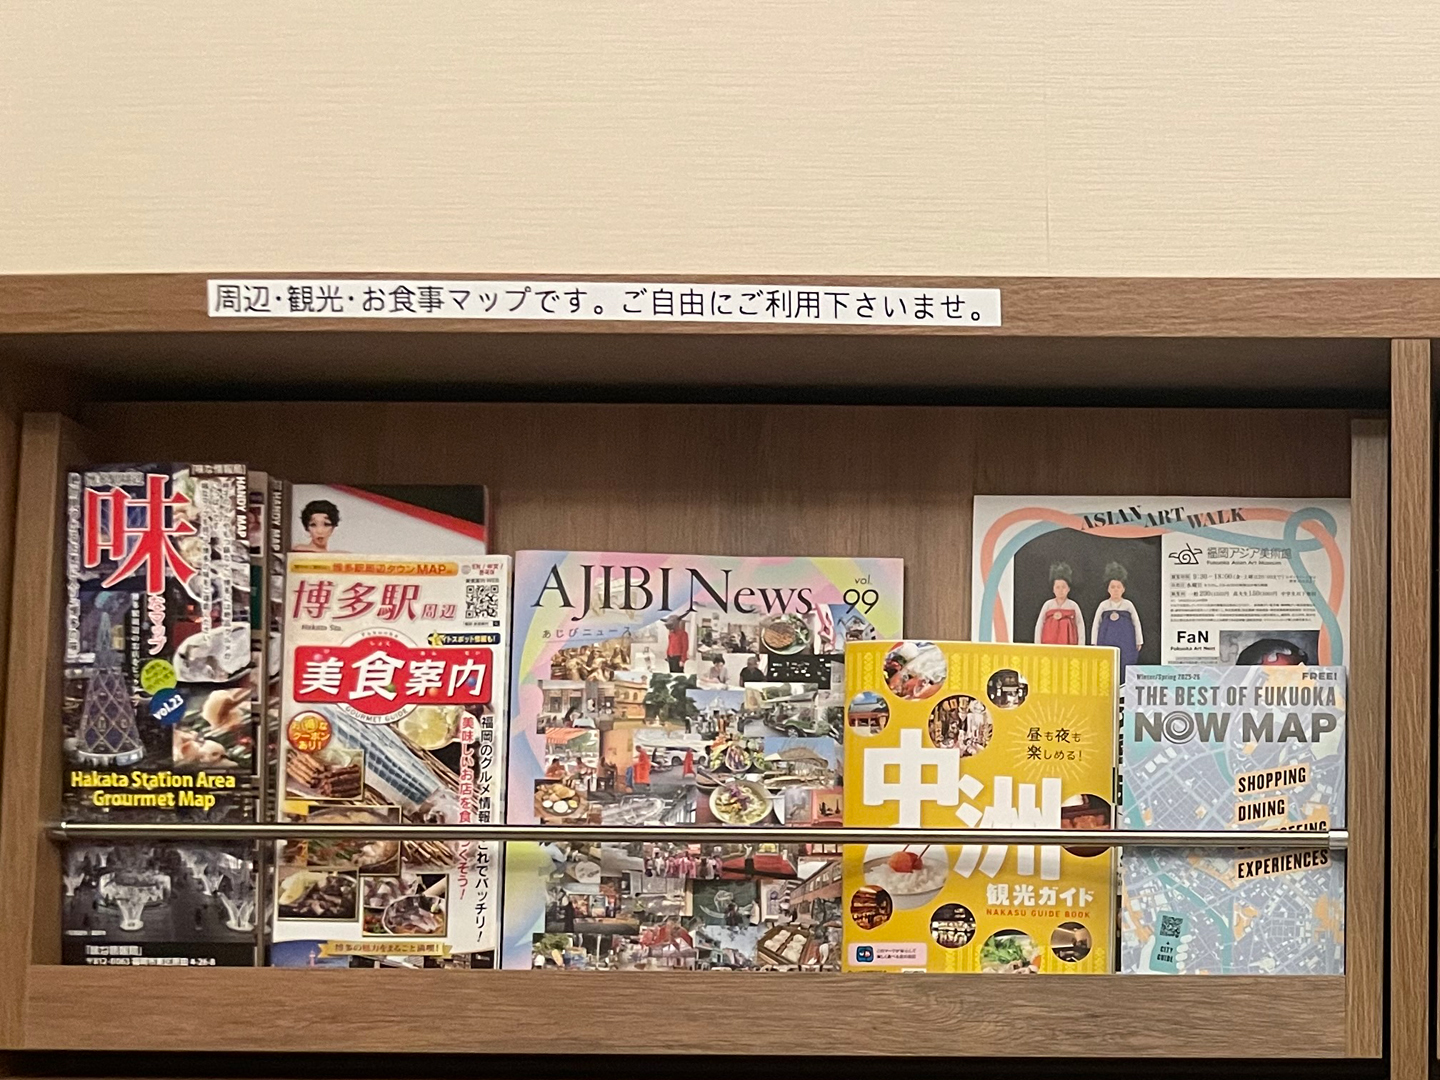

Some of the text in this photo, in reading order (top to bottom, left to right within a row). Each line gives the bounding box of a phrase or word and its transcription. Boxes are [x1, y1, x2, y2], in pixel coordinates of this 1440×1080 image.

[214, 282, 985, 323] 周辺・観光・お食事マップです。ご自由にご利用下さいませ。
[236, 477, 247, 538] HANDY MAP
[1081, 505, 1247, 531] ASIAN ART WALK
[84, 474, 198, 596] 味
[291, 580, 457, 621] 博多駅 周辺
[530, 563, 812, 621] AJIBI News
[843, 588, 880, 614] 99
[541, 625, 632, 640] あじびニュース
[1176, 630, 1209, 643] FaN
[299, 650, 487, 702] 美食案内
[1302, 672, 1338, 681] FREE!
[153, 694, 184, 721] vol.23
[1135, 686, 1337, 707] THE BEST OF FUKUOKA
[1026, 726, 1082, 744] 昼も夜も
[1134, 711, 1337, 744] NOW MAP
[1026, 744, 1083, 762] 楽しめる!
[71, 771, 236, 789] Hakata Station Area
[1238, 767, 1307, 793] SHOPPING
[92, 790, 216, 811] Grourmet Map
[1238, 799, 1286, 822] DINING
[1238, 850, 1329, 879] EXPERIENCES
[986, 883, 1094, 908] 観光ガイド
[986, 908, 1091, 919] NAKASU GUIDE BOOK
